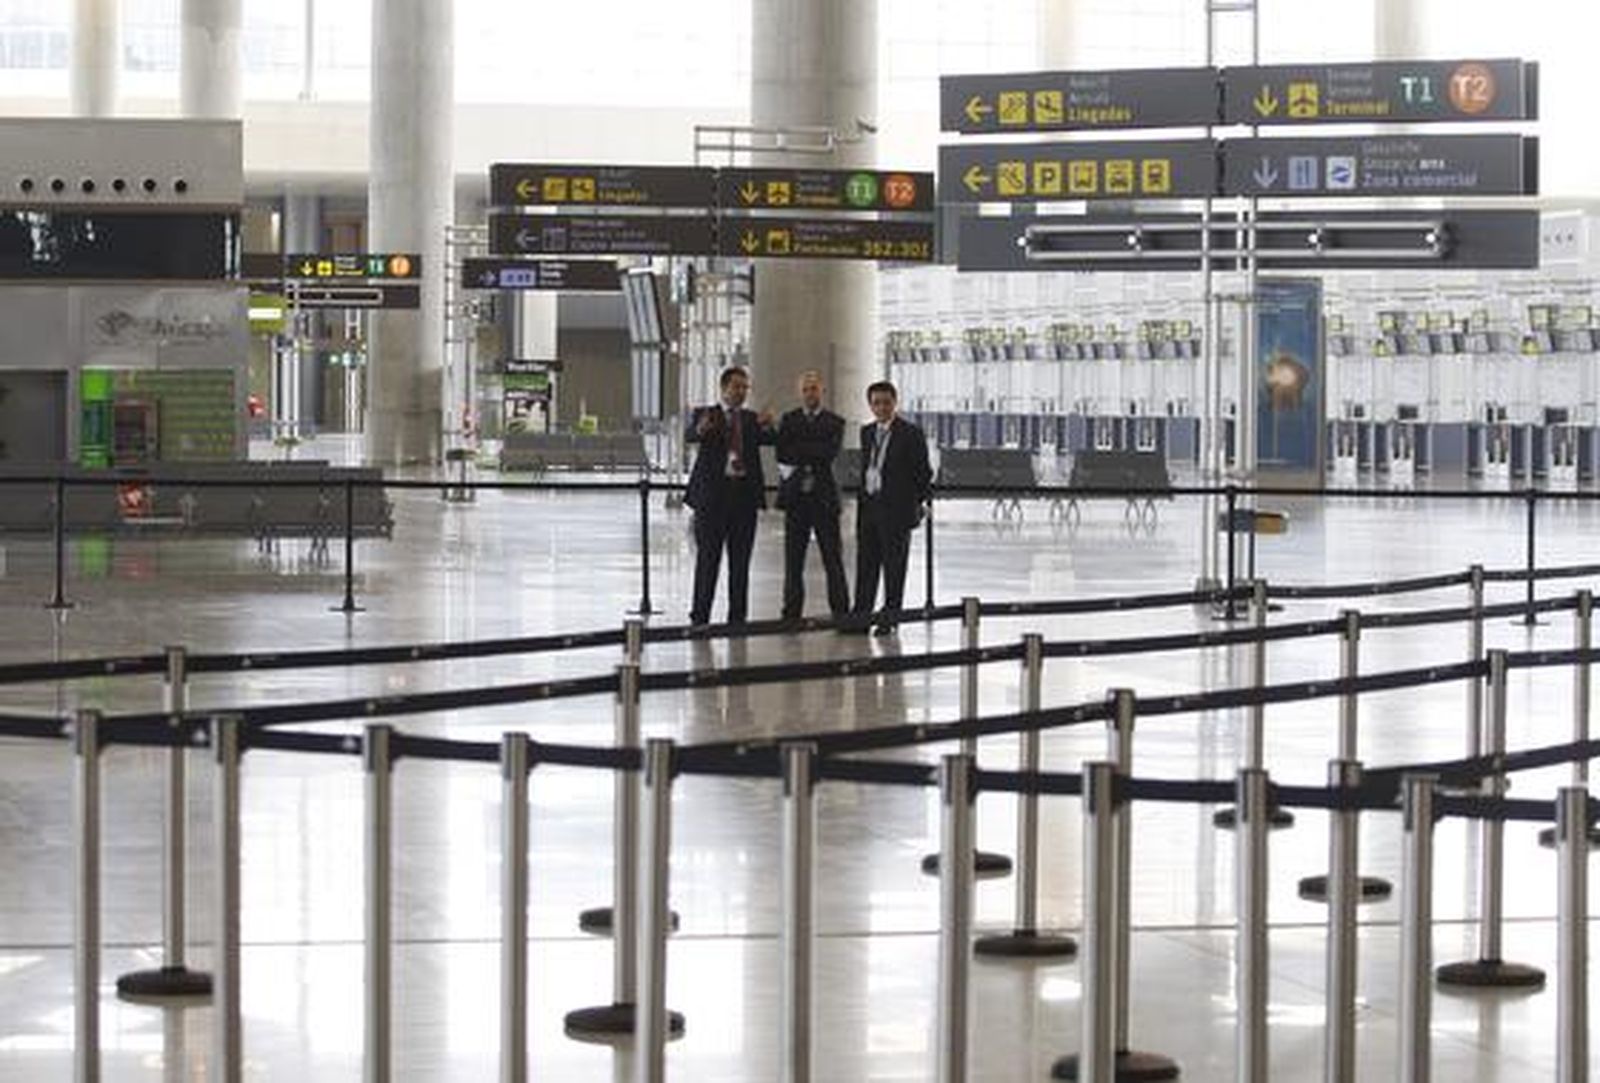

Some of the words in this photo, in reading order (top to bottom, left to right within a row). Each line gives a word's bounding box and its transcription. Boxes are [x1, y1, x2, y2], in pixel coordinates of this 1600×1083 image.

[1399, 77, 1435, 103] T1
[1453, 75, 1488, 102] T2
[1040, 165, 1056, 186] P
[851, 181, 873, 201] T1
